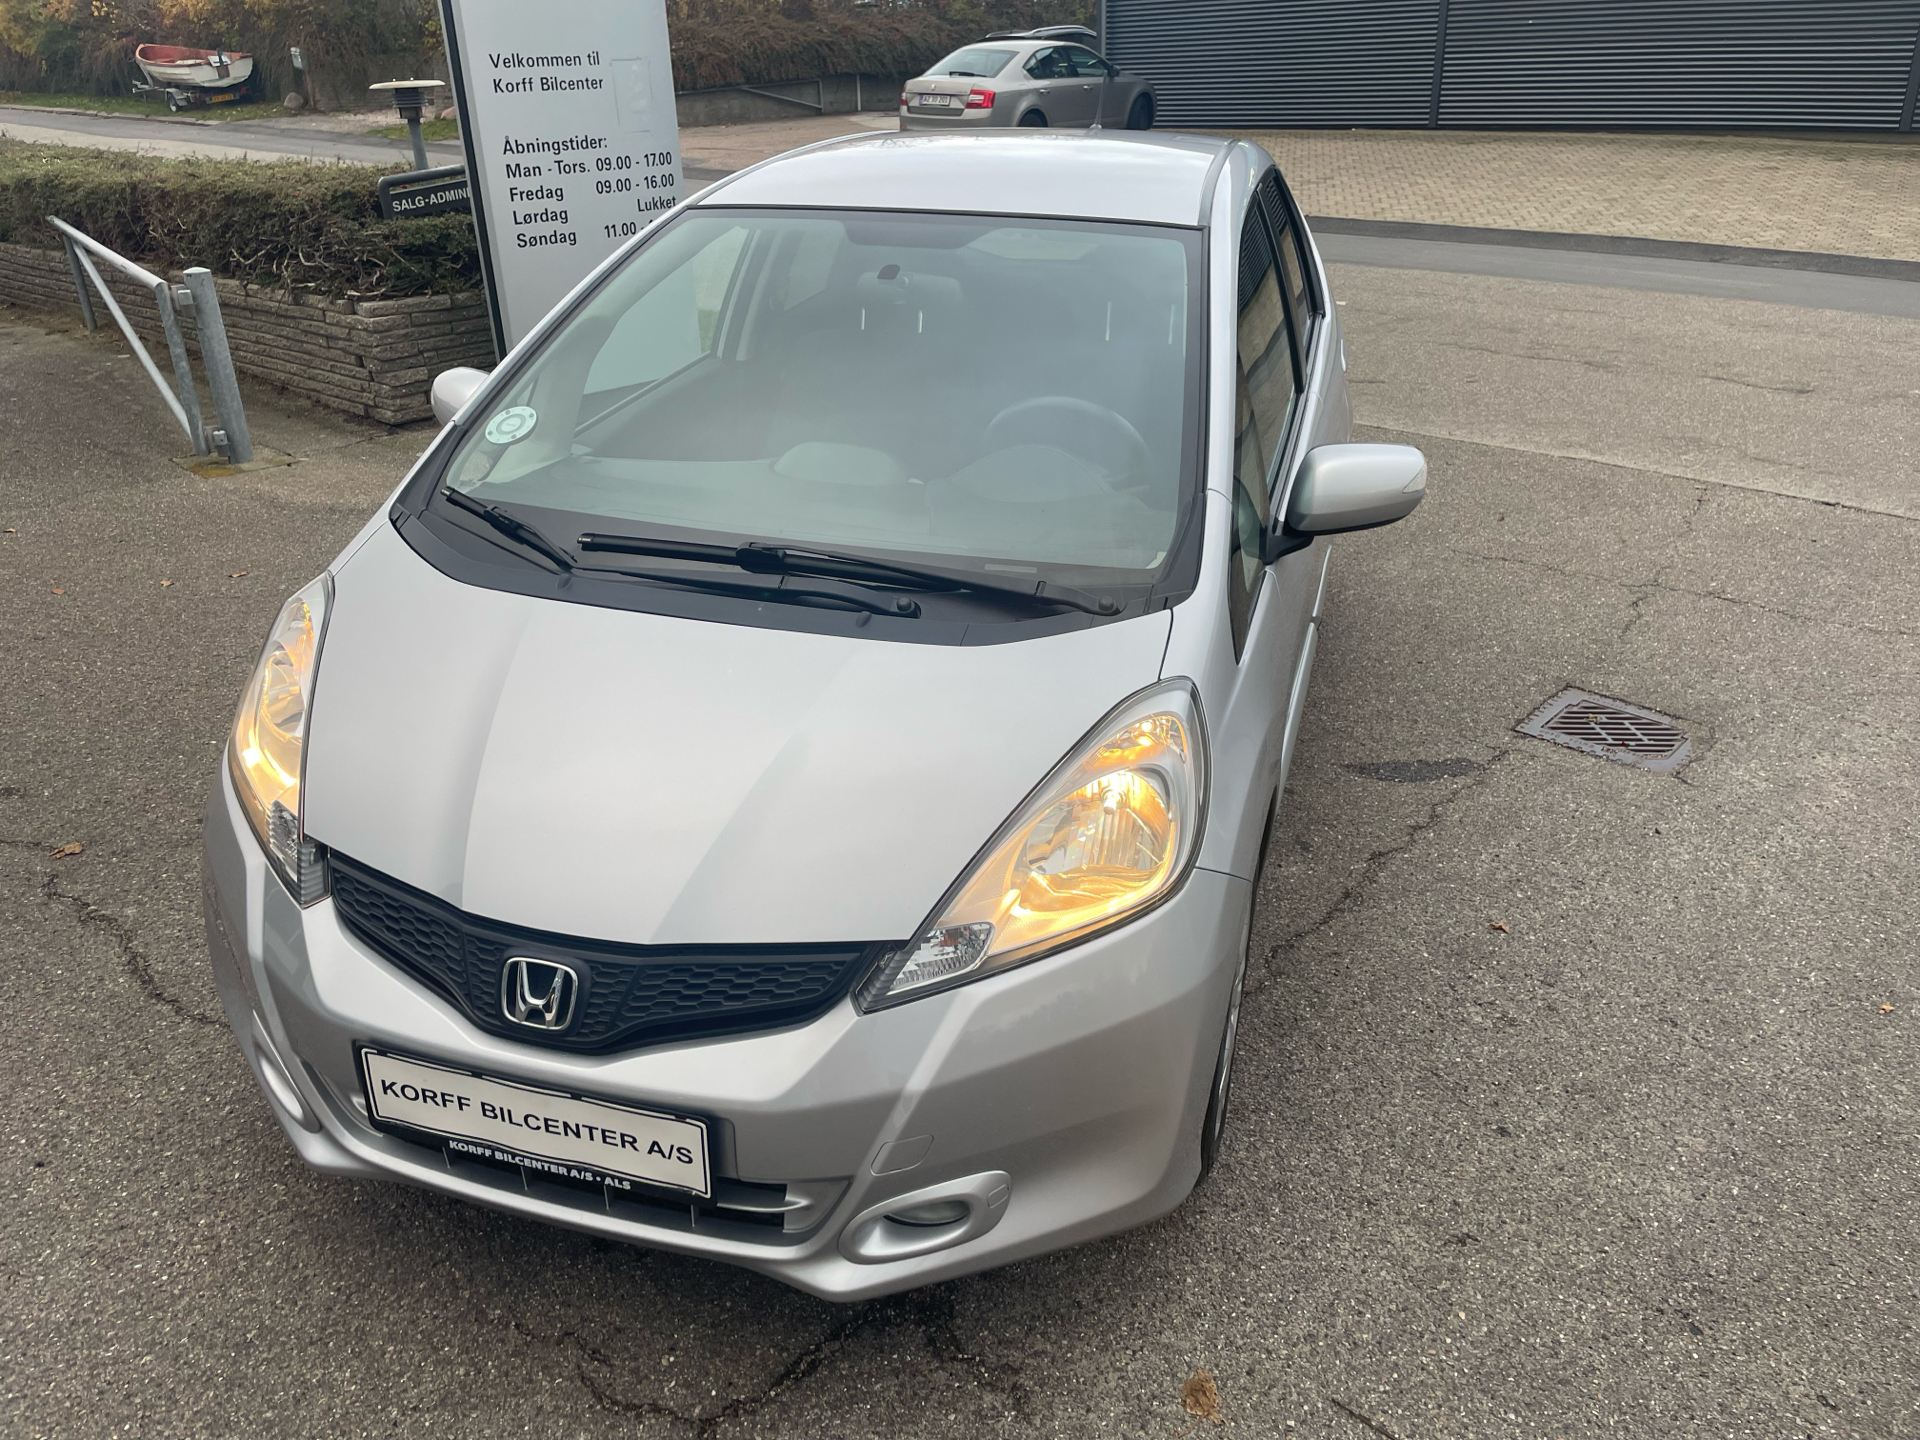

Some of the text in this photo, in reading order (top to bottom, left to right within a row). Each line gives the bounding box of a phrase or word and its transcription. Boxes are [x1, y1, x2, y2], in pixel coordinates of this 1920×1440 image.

[489, 50, 600, 69] Velkommen til
[493, 76, 604, 94] Korff Bilcenter
[503, 135, 608, 156] Åbningstider:
[506, 162, 543, 179] Man
[553, 160, 591, 175] Tors.
[595, 155, 632, 172] 09.00
[643, 151, 673, 168] 17.00
[509, 185, 564, 203] Fredag
[595, 177, 632, 195] 09.00
[643, 172, 675, 190] 16.00
[512, 195, 677, 226] Lørdag Lukket
[516, 230, 577, 249] Søndag
[604, 221, 637, 239] 11.00
[381, 1078, 694, 1165] KORFF BILCENTER A/S
[448, 1139, 632, 1191] KORFF BILCENTER A/S ALS
